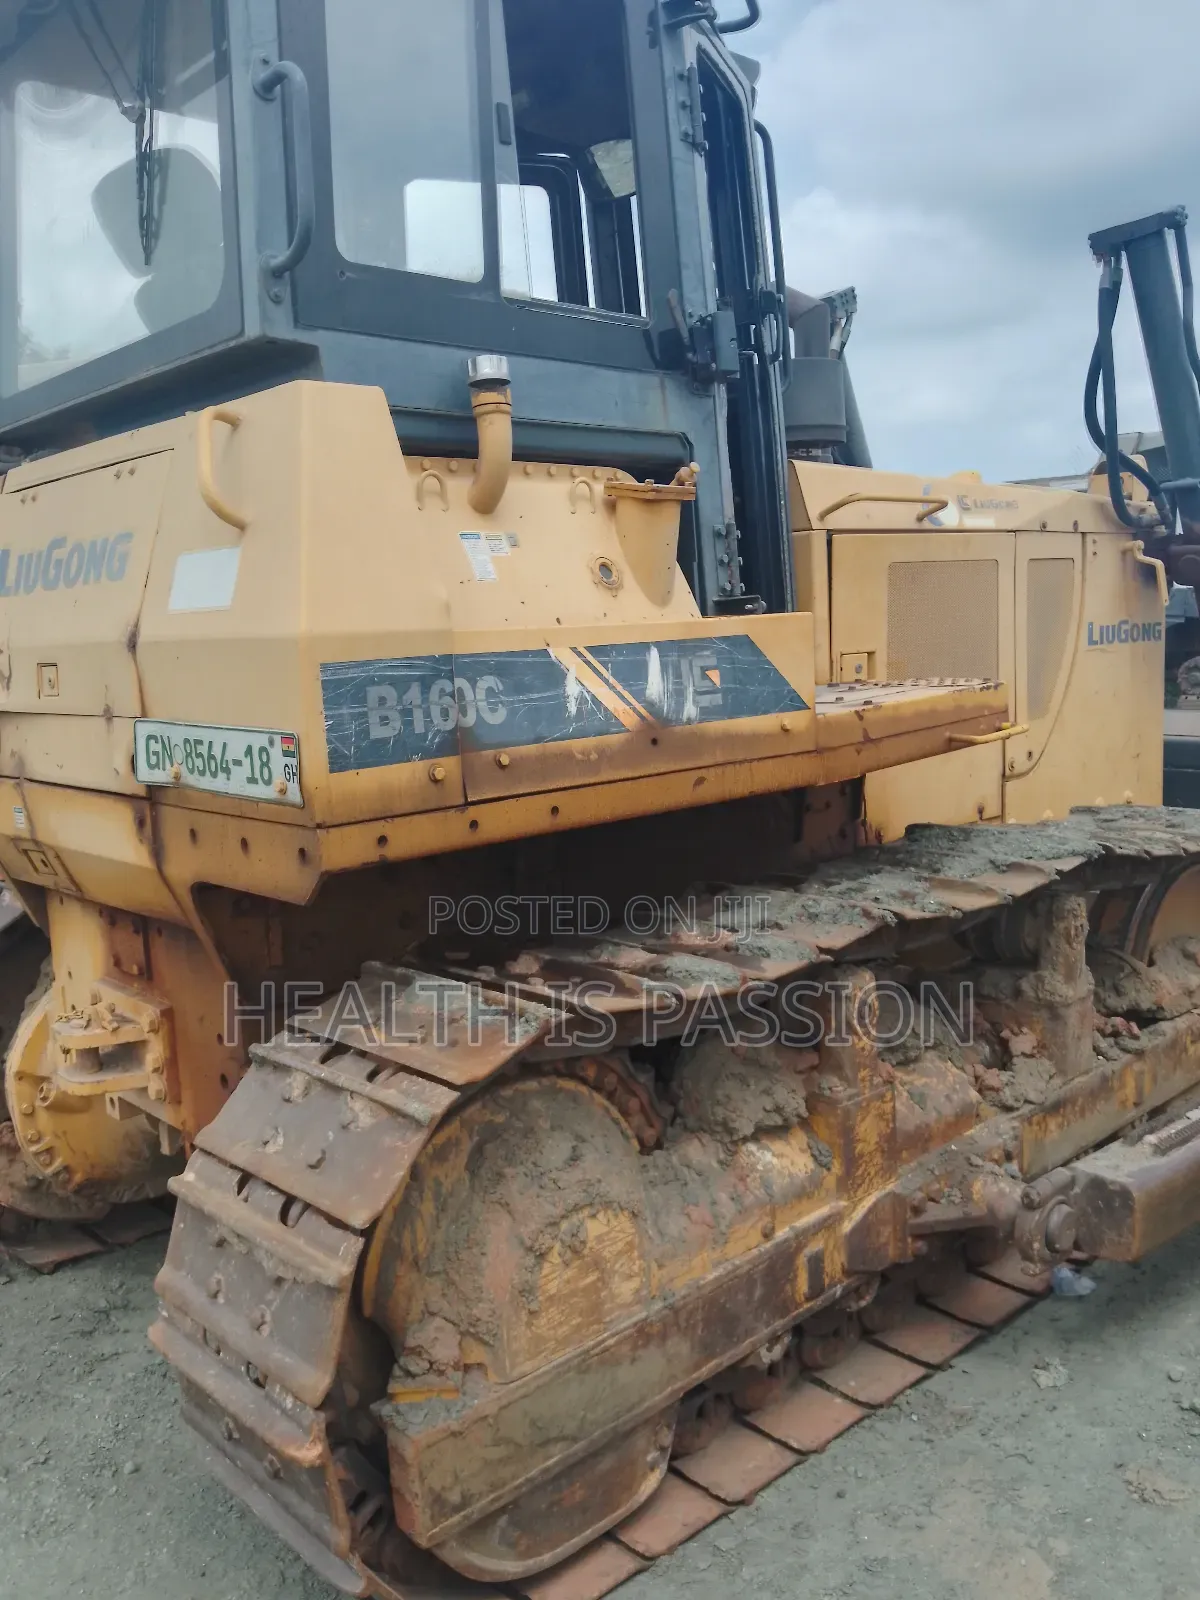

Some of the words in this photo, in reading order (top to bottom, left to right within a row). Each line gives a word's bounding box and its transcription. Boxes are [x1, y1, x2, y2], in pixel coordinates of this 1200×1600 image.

[366, 675, 507, 740] B160C
[145, 734, 174, 771] GN
[182, 737, 273, 787] 8564-18
[283, 763, 299, 784] GH
